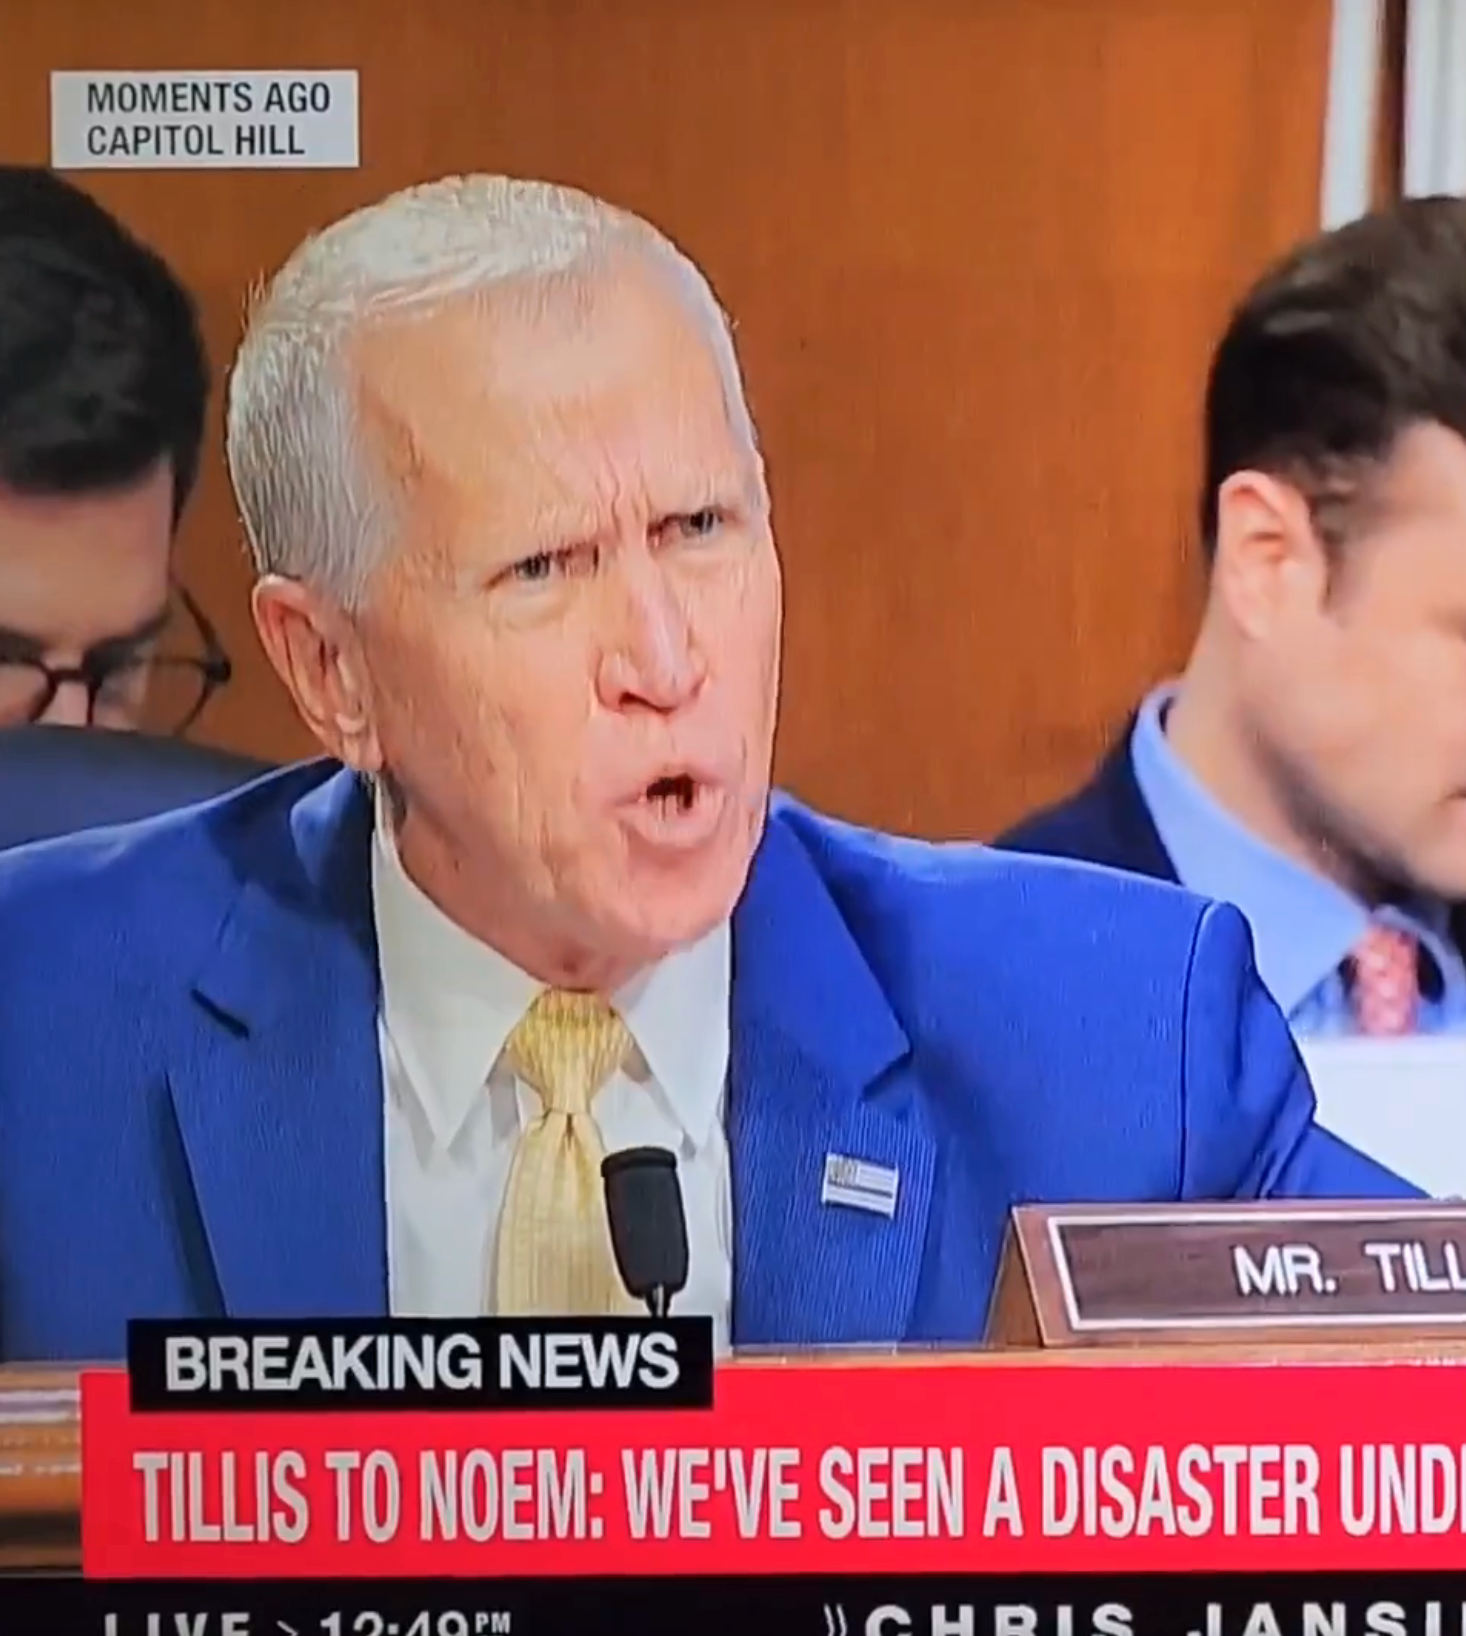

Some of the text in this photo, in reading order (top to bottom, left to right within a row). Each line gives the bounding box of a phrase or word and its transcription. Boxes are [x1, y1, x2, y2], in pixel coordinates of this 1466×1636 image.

[87, 82, 330, 113] MOMENTS AGO
[87, 124, 305, 156] CAPITOL HILL
[1233, 1243, 1337, 1294] MR.
[165, 1332, 680, 1391] BREAKING NEWS
[133, 1450, 309, 1543] TILLIS
[325, 1450, 400, 1543] TO
[420, 1448, 604, 1542] NOEM:
[621, 1447, 802, 1540] WE'VE
[818, 1446, 964, 1540] SEEN
[982, 1446, 1024, 1538] A
[1041, 1443, 1320, 1538] DISASTER
[865, 1603, 1134, 1636] CHRIS
